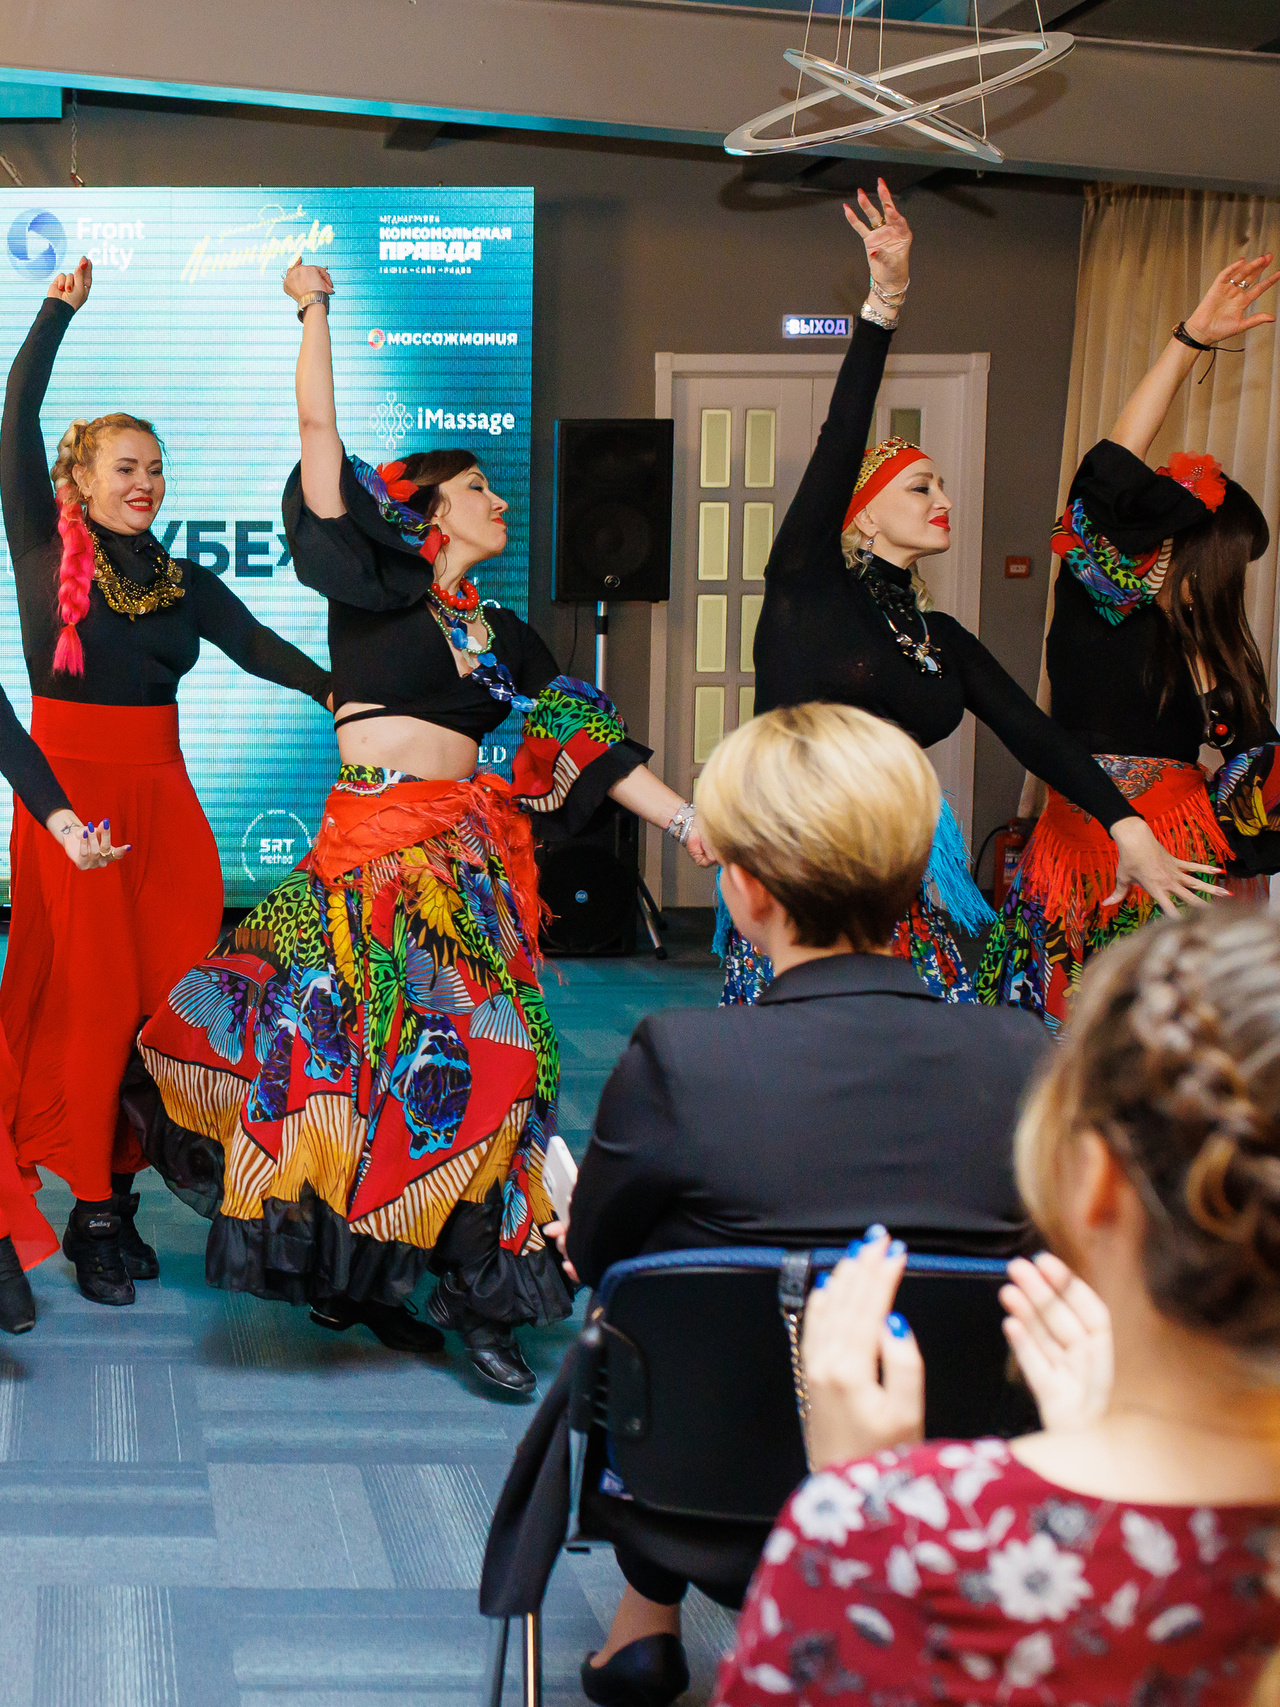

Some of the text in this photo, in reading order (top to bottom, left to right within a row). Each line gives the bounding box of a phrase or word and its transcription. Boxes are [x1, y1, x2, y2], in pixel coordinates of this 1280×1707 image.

[77, 217, 145, 240] Front
[379, 227, 512, 240] КОМСОМОЛЬСКАЯ
[87, 240, 134, 272] city
[379, 242, 482, 262] ПРАВДА
[789, 319, 847, 335] ВЫХОД
[417, 407, 516, 435] iMassage
